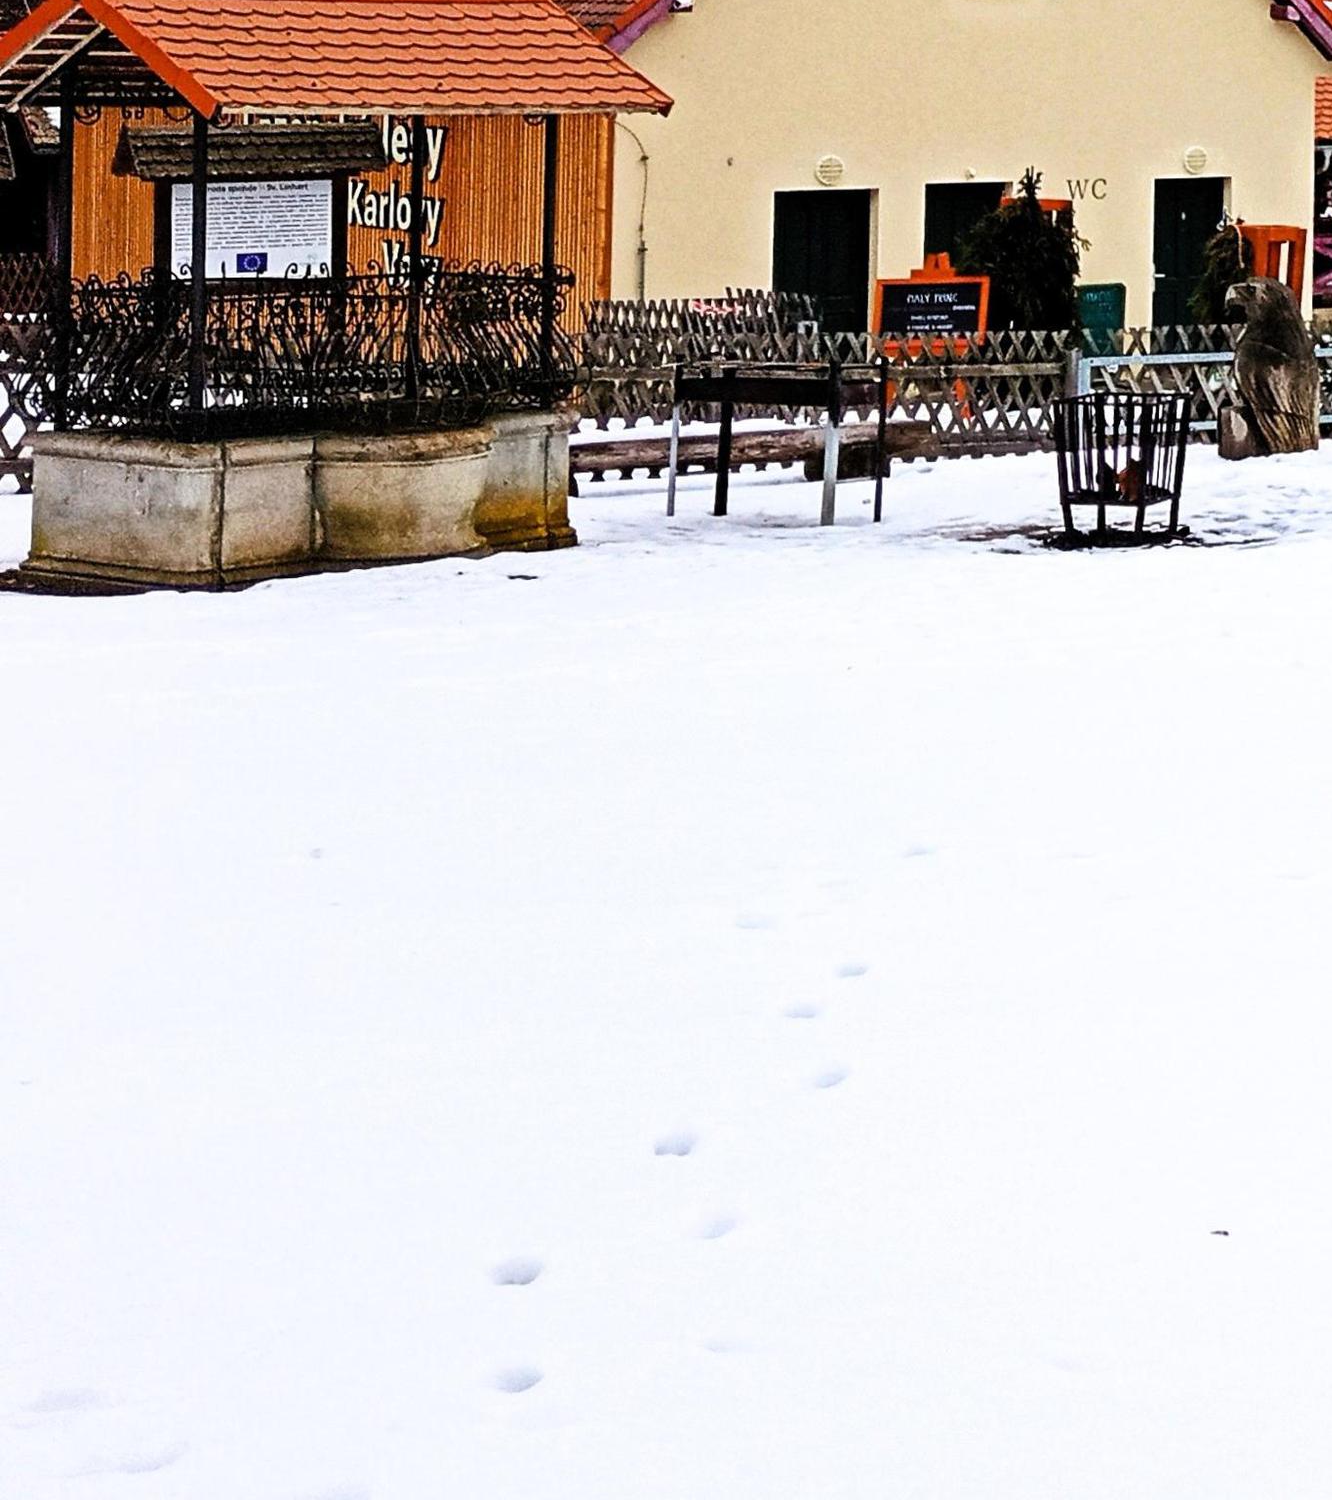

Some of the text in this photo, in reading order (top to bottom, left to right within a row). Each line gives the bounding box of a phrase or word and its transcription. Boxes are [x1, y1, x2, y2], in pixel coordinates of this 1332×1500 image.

[382, 114, 444, 181] ley
[348, 181, 441, 246] Karloy
[1067, 179, 1107, 200] WC
